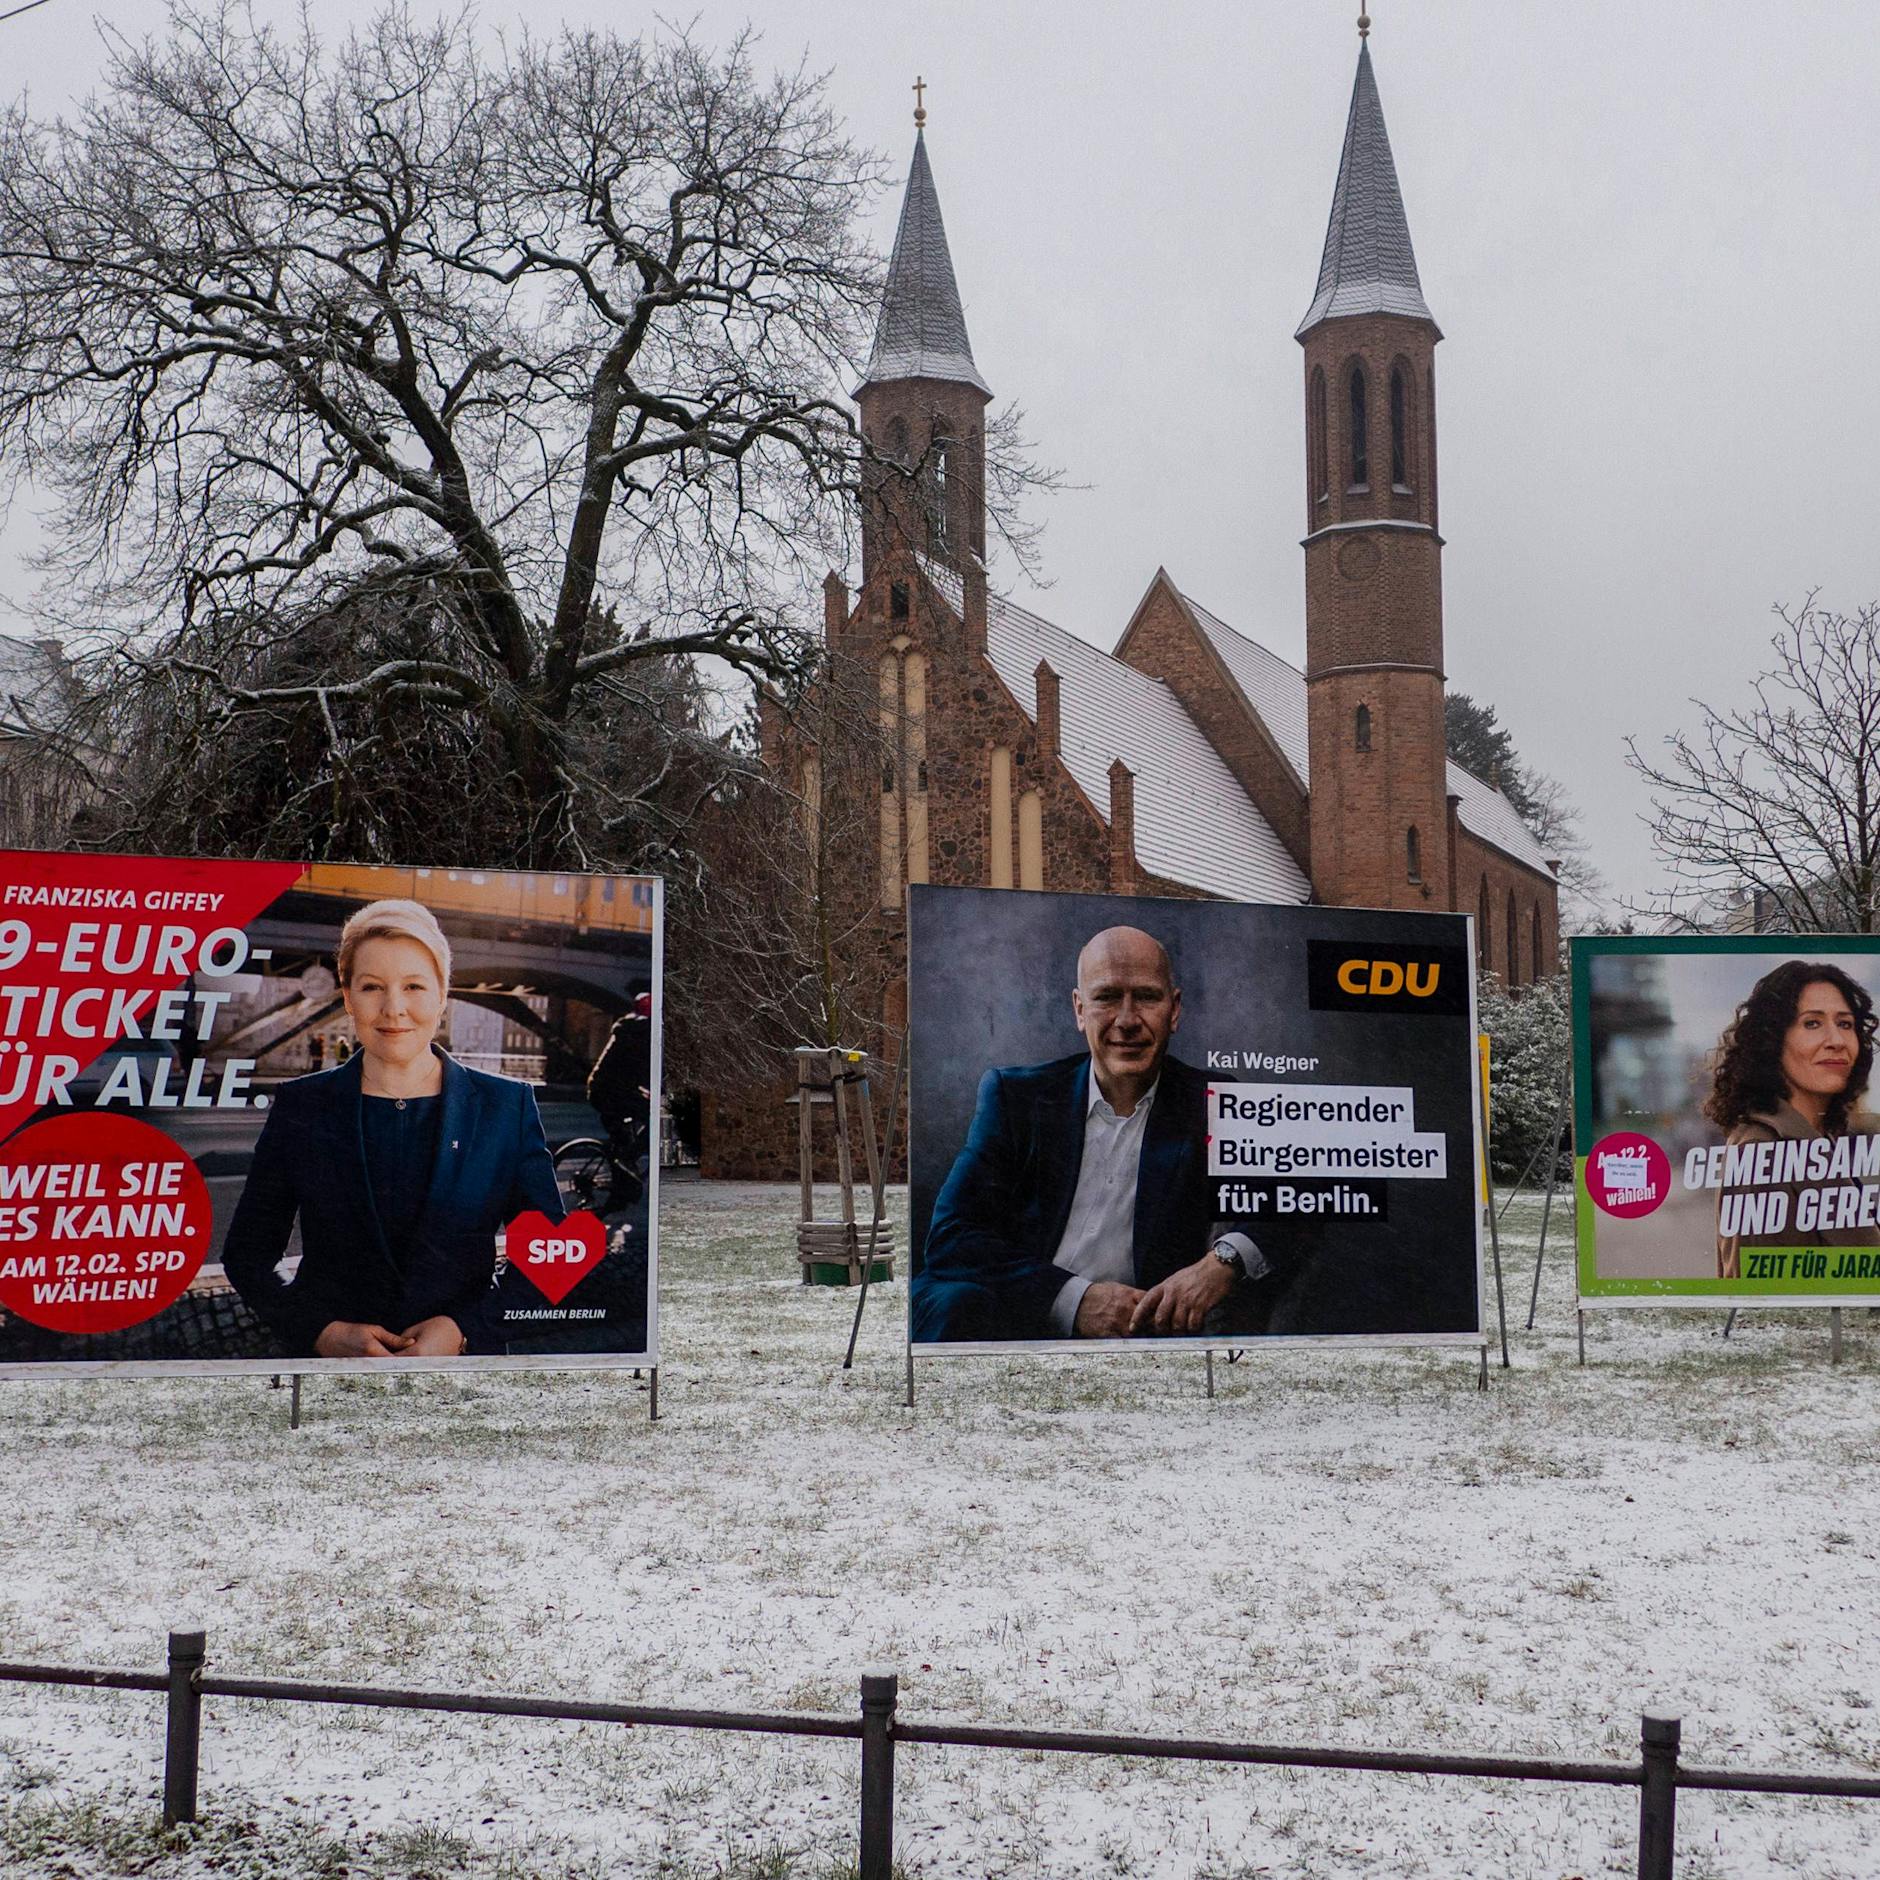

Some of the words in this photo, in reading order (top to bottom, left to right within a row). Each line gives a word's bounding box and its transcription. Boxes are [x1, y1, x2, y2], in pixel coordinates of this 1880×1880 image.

[4, 886, 137, 909] FRANZISKA
[144, 891, 225, 912] GIFFEY
[1337, 959, 1440, 997] CDU
[1, 985, 232, 1041] TICKET
[1207, 1051, 1238, 1069] Kai
[1242, 1052, 1319, 1074] Wegner
[94, 1056, 270, 1109] ALLE.
[1218, 1093, 1405, 1127] Regierender
[1218, 1139, 1439, 1173] Bürgermeister
[1597, 1151, 1618, 1169] A
[1683, 1134, 1880, 1190] GEMEINSAM
[0, 1164, 106, 1199] WEIL
[118, 1162, 184, 1198] SIE
[1605, 1182, 1656, 1207] wählen!
[1217, 1184, 1269, 1213] für
[1275, 1185, 1379, 1214] Berlin.
[1719, 1190, 1789, 1237] UND
[1795, 1184, 1880, 1232] GERE
[0, 1206, 39, 1241] ES
[51, 1203, 196, 1240] KANN.
[0, 1257, 46, 1278] AM
[55, 1253, 126, 1276] 12.02.
[135, 1251, 186, 1273] SPD
[527, 1239, 587, 1264] SPD
[1746, 1254, 1788, 1278] ZEIT
[1791, 1251, 1828, 1278] FÜR
[1831, 1254, 1880, 1279] JARA
[32, 1277, 158, 1304] WÄHLEN!
[503, 1309, 567, 1320] ZUSAMMEN
[568, 1309, 606, 1319] BERLIN
